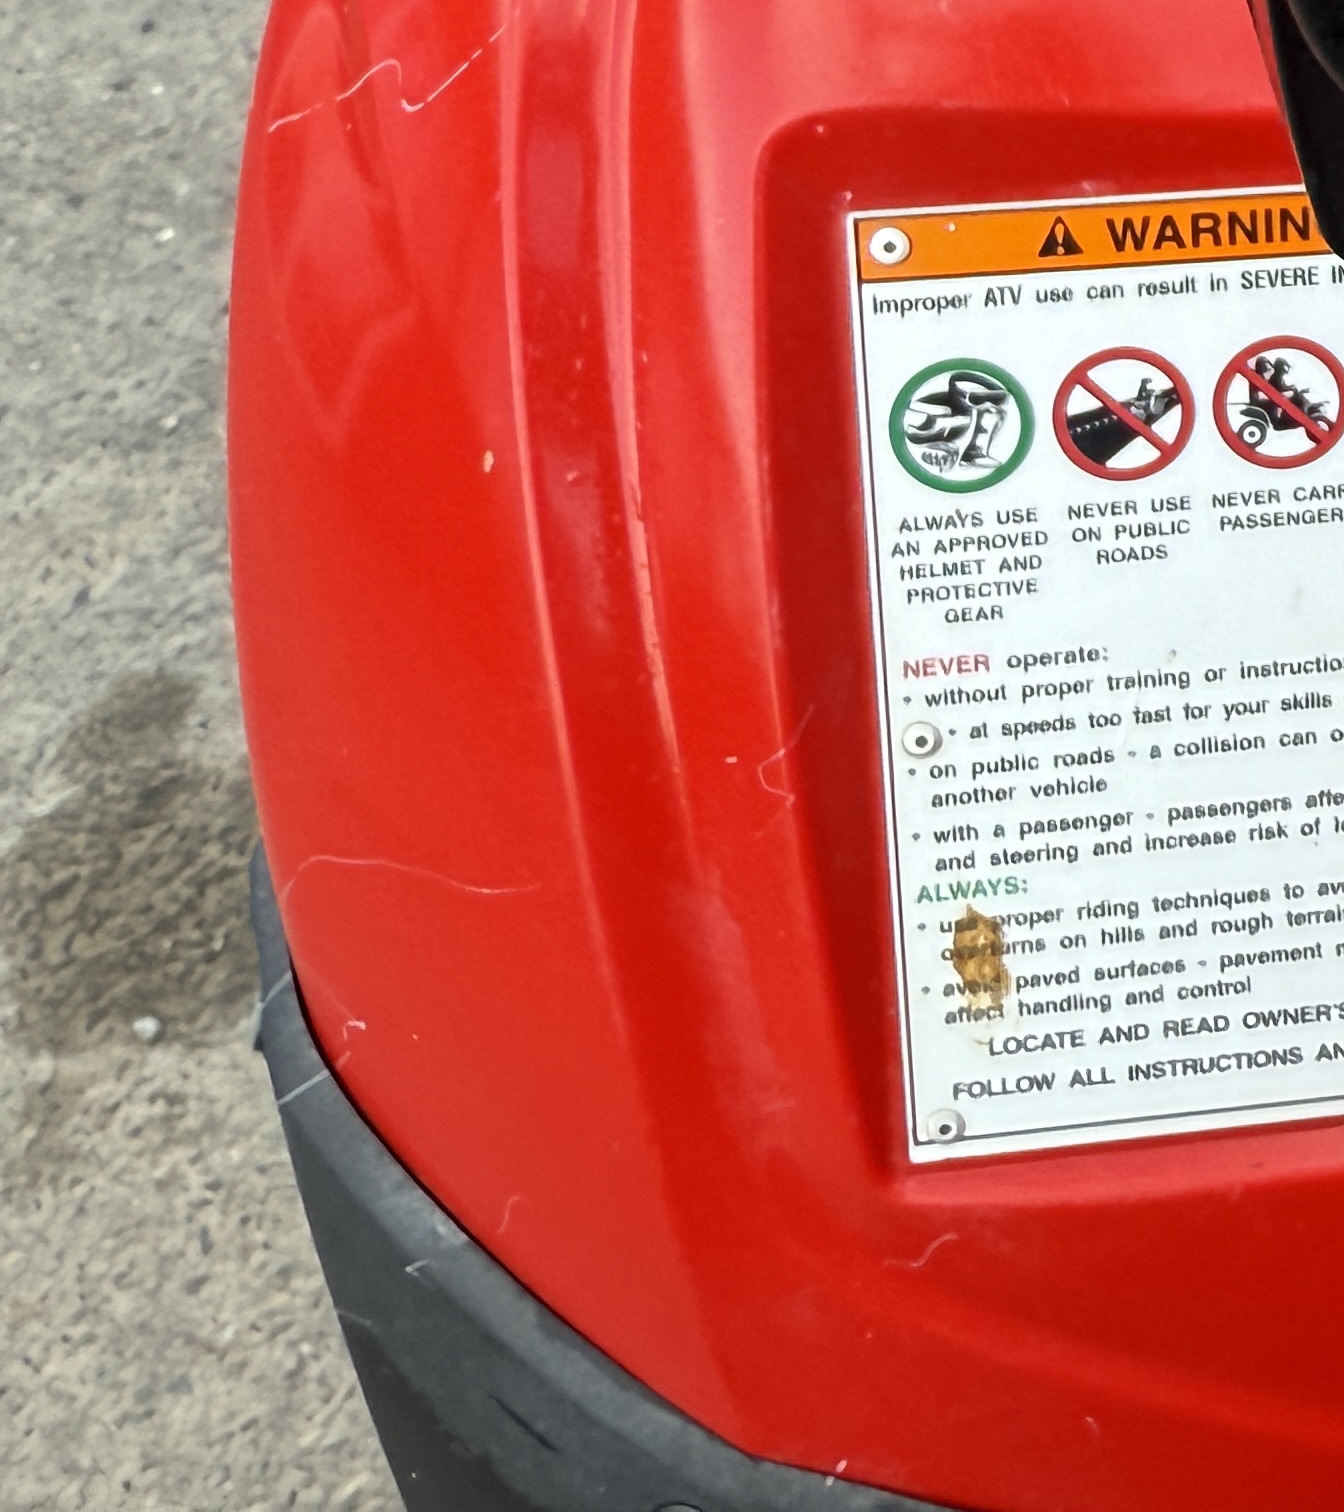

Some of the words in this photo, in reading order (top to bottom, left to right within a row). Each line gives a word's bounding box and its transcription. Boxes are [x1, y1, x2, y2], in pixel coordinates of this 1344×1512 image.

[1106, 206, 1310, 252] WARNIN
[873, 294, 972, 318] Improper
[984, 285, 1021, 307] ATV
[1036, 287, 1073, 303] use
[1087, 285, 1124, 301] can
[1138, 275, 1198, 297] result
[1210, 273, 1228, 292] in
[1241, 266, 1319, 290] SEVERE
[1068, 501, 1137, 520] NEVER
[1151, 496, 1191, 513] USE
[1212, 489, 1280, 508] NEVER
[899, 509, 983, 534] ALWAYS
[997, 508, 1038, 525] USE
[1072, 527, 1101, 542] ON
[1115, 519, 1190, 540] PUBLIC
[891, 541, 920, 558] AN
[934, 531, 1048, 555] APPROVED
[1097, 544, 1168, 565] ROADS
[900, 559, 985, 581] HELMET
[999, 555, 1042, 573] AND
[907, 578, 1038, 605] PROTECTIVE
[944, 605, 1003, 623] GEAR
[903, 654, 990, 679] NEVER
[1007, 646, 1108, 673] operate:
[925, 684, 1007, 707] without
[1022, 679, 1093, 704] proper
[1107, 669, 1190, 691] training
[1204, 668, 1226, 682] or
[969, 722, 988, 739] at
[1002, 715, 1076, 741] speeds
[1088, 712, 1121, 728] too
[1133, 706, 1172, 724] fast
[1183, 703, 1211, 721] for
[1223, 700, 1269, 722] your
[1281, 692, 1332, 711] skills
[930, 764, 956, 779] on
[972, 754, 1039, 781] public
[1054, 747, 1115, 768] roads
[1150, 745, 1161, 759] a
[1174, 734, 1265, 756] collision
[1279, 732, 1317, 747] can
[931, 786, 1016, 808] another
[1030, 775, 1107, 798] vehicle
[933, 824, 978, 844] with
[993, 824, 1005, 838] a
[1020, 812, 1133, 840] passenger
[1168, 797, 1292, 828] passengers
[935, 850, 975, 872] and
[990, 843, 1078, 866] steering
[1093, 835, 1132, 856] and
[1145, 830, 1236, 852] increase
[1249, 821, 1288, 841] risk
[1300, 817, 1320, 836] of
[917, 876, 1027, 904] ALWAYS:
[1077, 900, 1139, 920] riding
[1152, 888, 1270, 912] techniques
[1284, 883, 1304, 900] to
[1060, 935, 1086, 949] on
[1101, 926, 1145, 946] hills
[1159, 919, 1197, 940] and
[1211, 912, 1273, 936] rough
[1016, 966, 1080, 994] paved
[1094, 959, 1186, 981] surfaces
[1220, 942, 1322, 974] pavement
[1018, 994, 1111, 1017] handling
[1125, 984, 1164, 1005] and
[1177, 976, 1251, 1000] control
[988, 1029, 1086, 1056] LOCATE
[1098, 1024, 1150, 1045] AND
[1163, 1015, 1230, 1038] READ
[953, 1072, 1055, 1100] FOLLOW
[1069, 1067, 1115, 1088] ALL
[1128, 1047, 1303, 1081] INSTRUCTIONS
